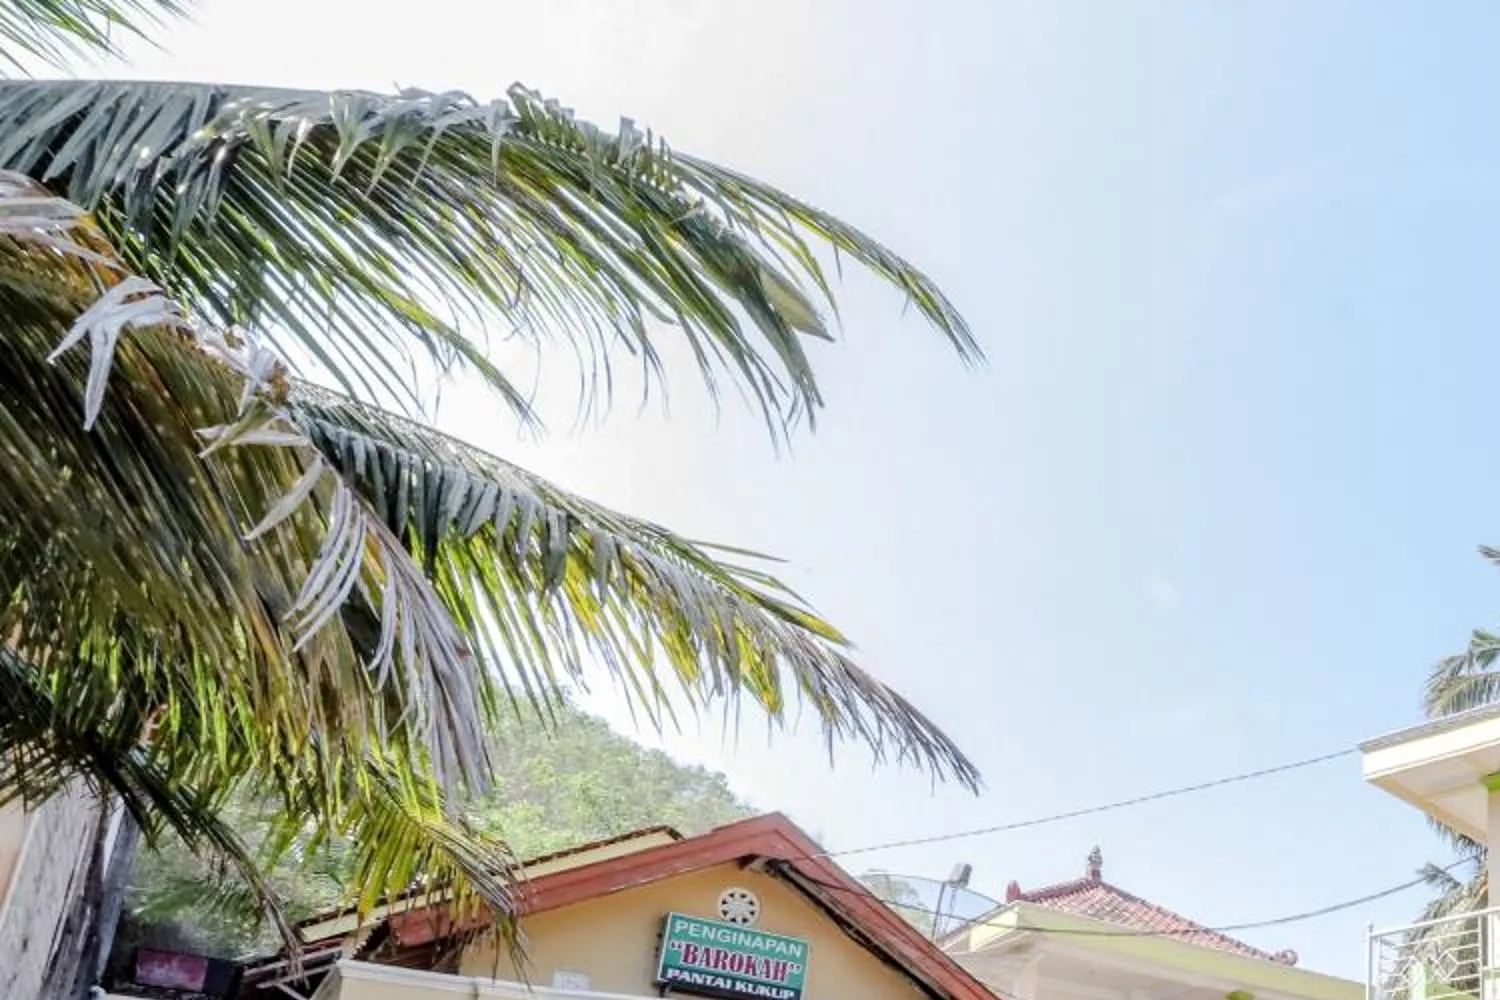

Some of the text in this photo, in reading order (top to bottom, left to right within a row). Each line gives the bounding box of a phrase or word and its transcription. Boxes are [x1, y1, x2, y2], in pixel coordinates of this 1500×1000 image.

[674, 920, 803, 958] PENGINAPAN
[666, 969, 795, 1000] PANTAI KUKUP
